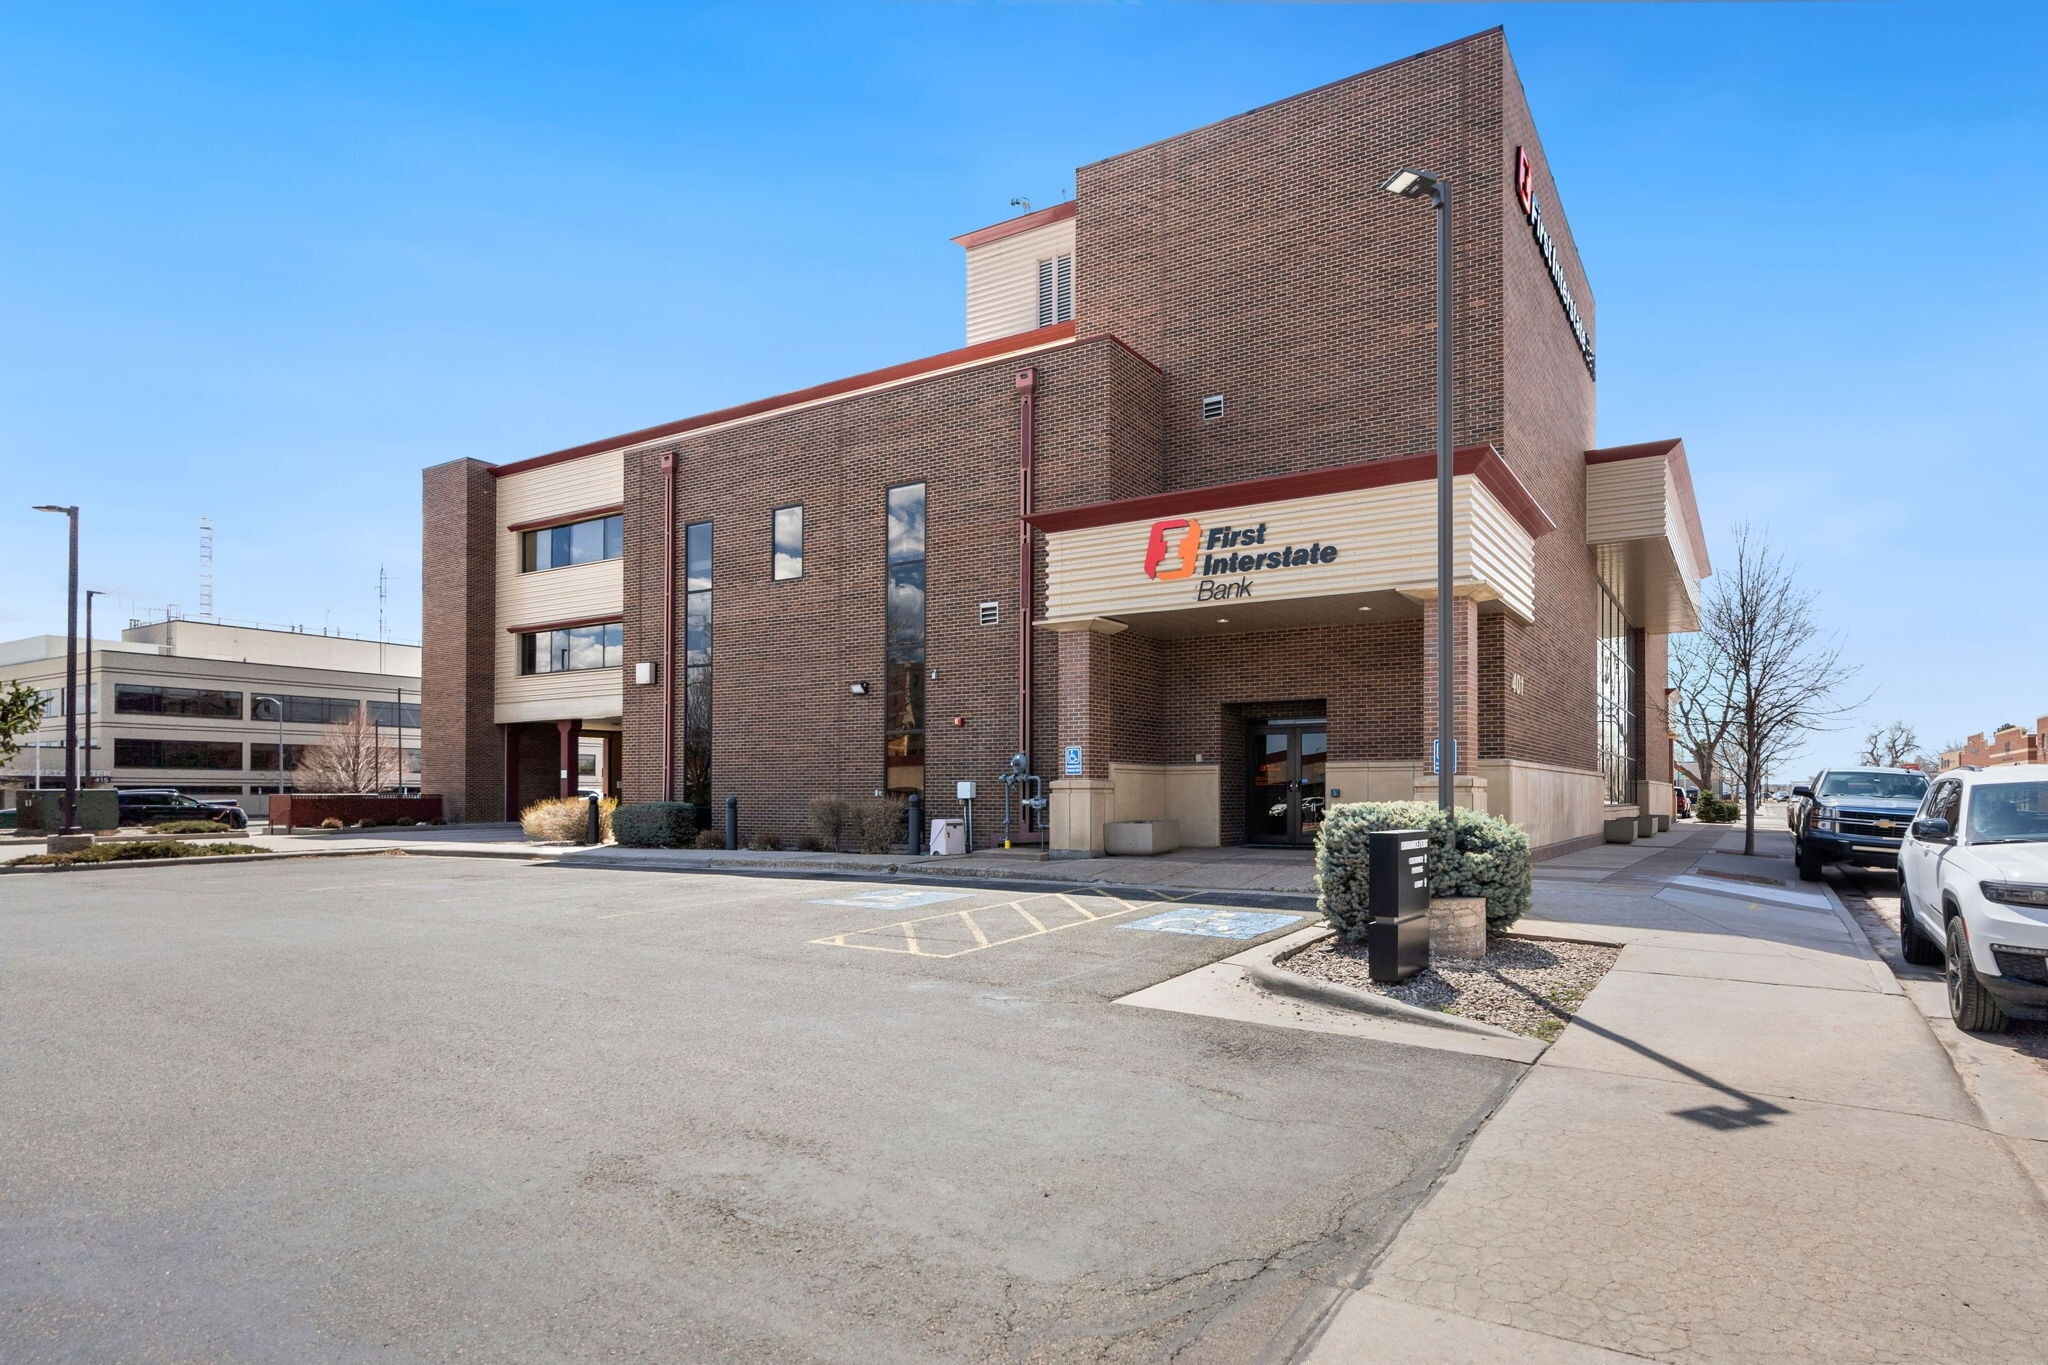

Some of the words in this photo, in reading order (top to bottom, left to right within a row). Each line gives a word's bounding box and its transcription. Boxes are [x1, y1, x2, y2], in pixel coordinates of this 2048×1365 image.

[1531, 191, 1552, 268] First
[1552, 246, 1586, 351] Interstate
[1206, 522, 1267, 550] First
[1202, 542, 1338, 576] Interstate
[1197, 576, 1254, 601] Bank
